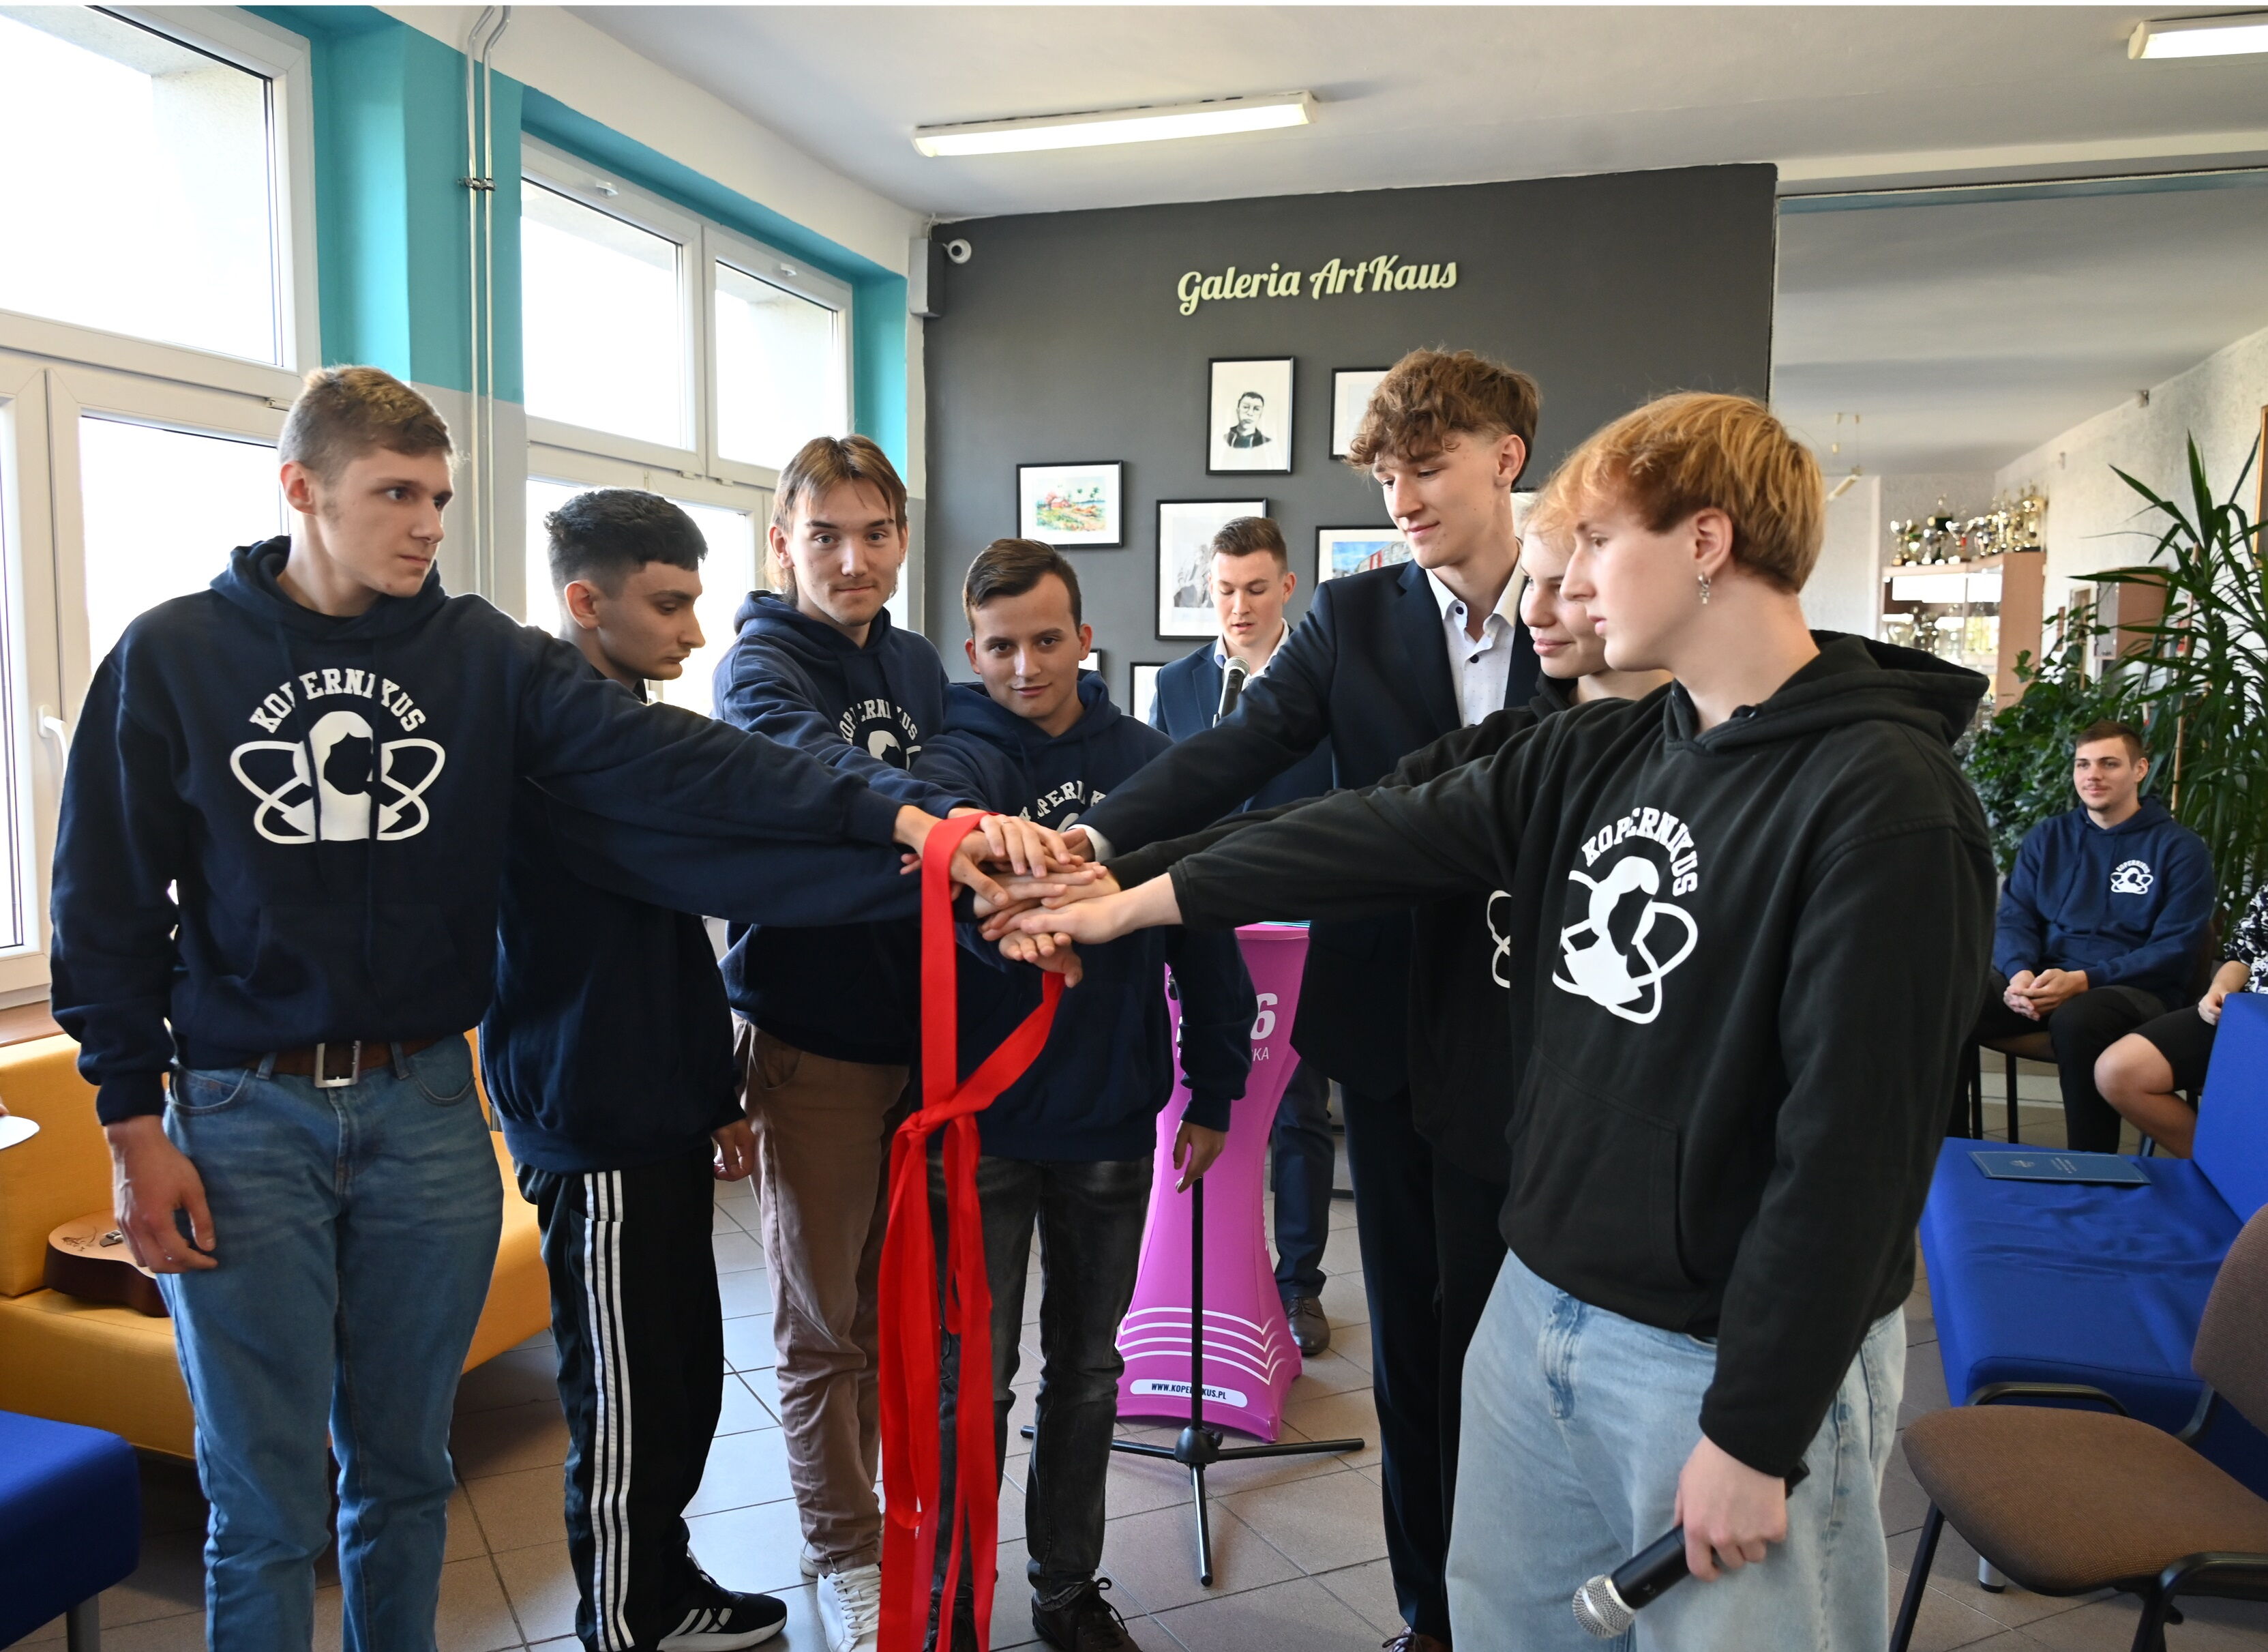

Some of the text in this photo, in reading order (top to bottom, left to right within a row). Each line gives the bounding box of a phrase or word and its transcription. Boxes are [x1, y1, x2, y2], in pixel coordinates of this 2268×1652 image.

[1177, 254, 1457, 316] Galeria ArtKaus
[1581, 806, 1699, 897] KOPERNIKUS
